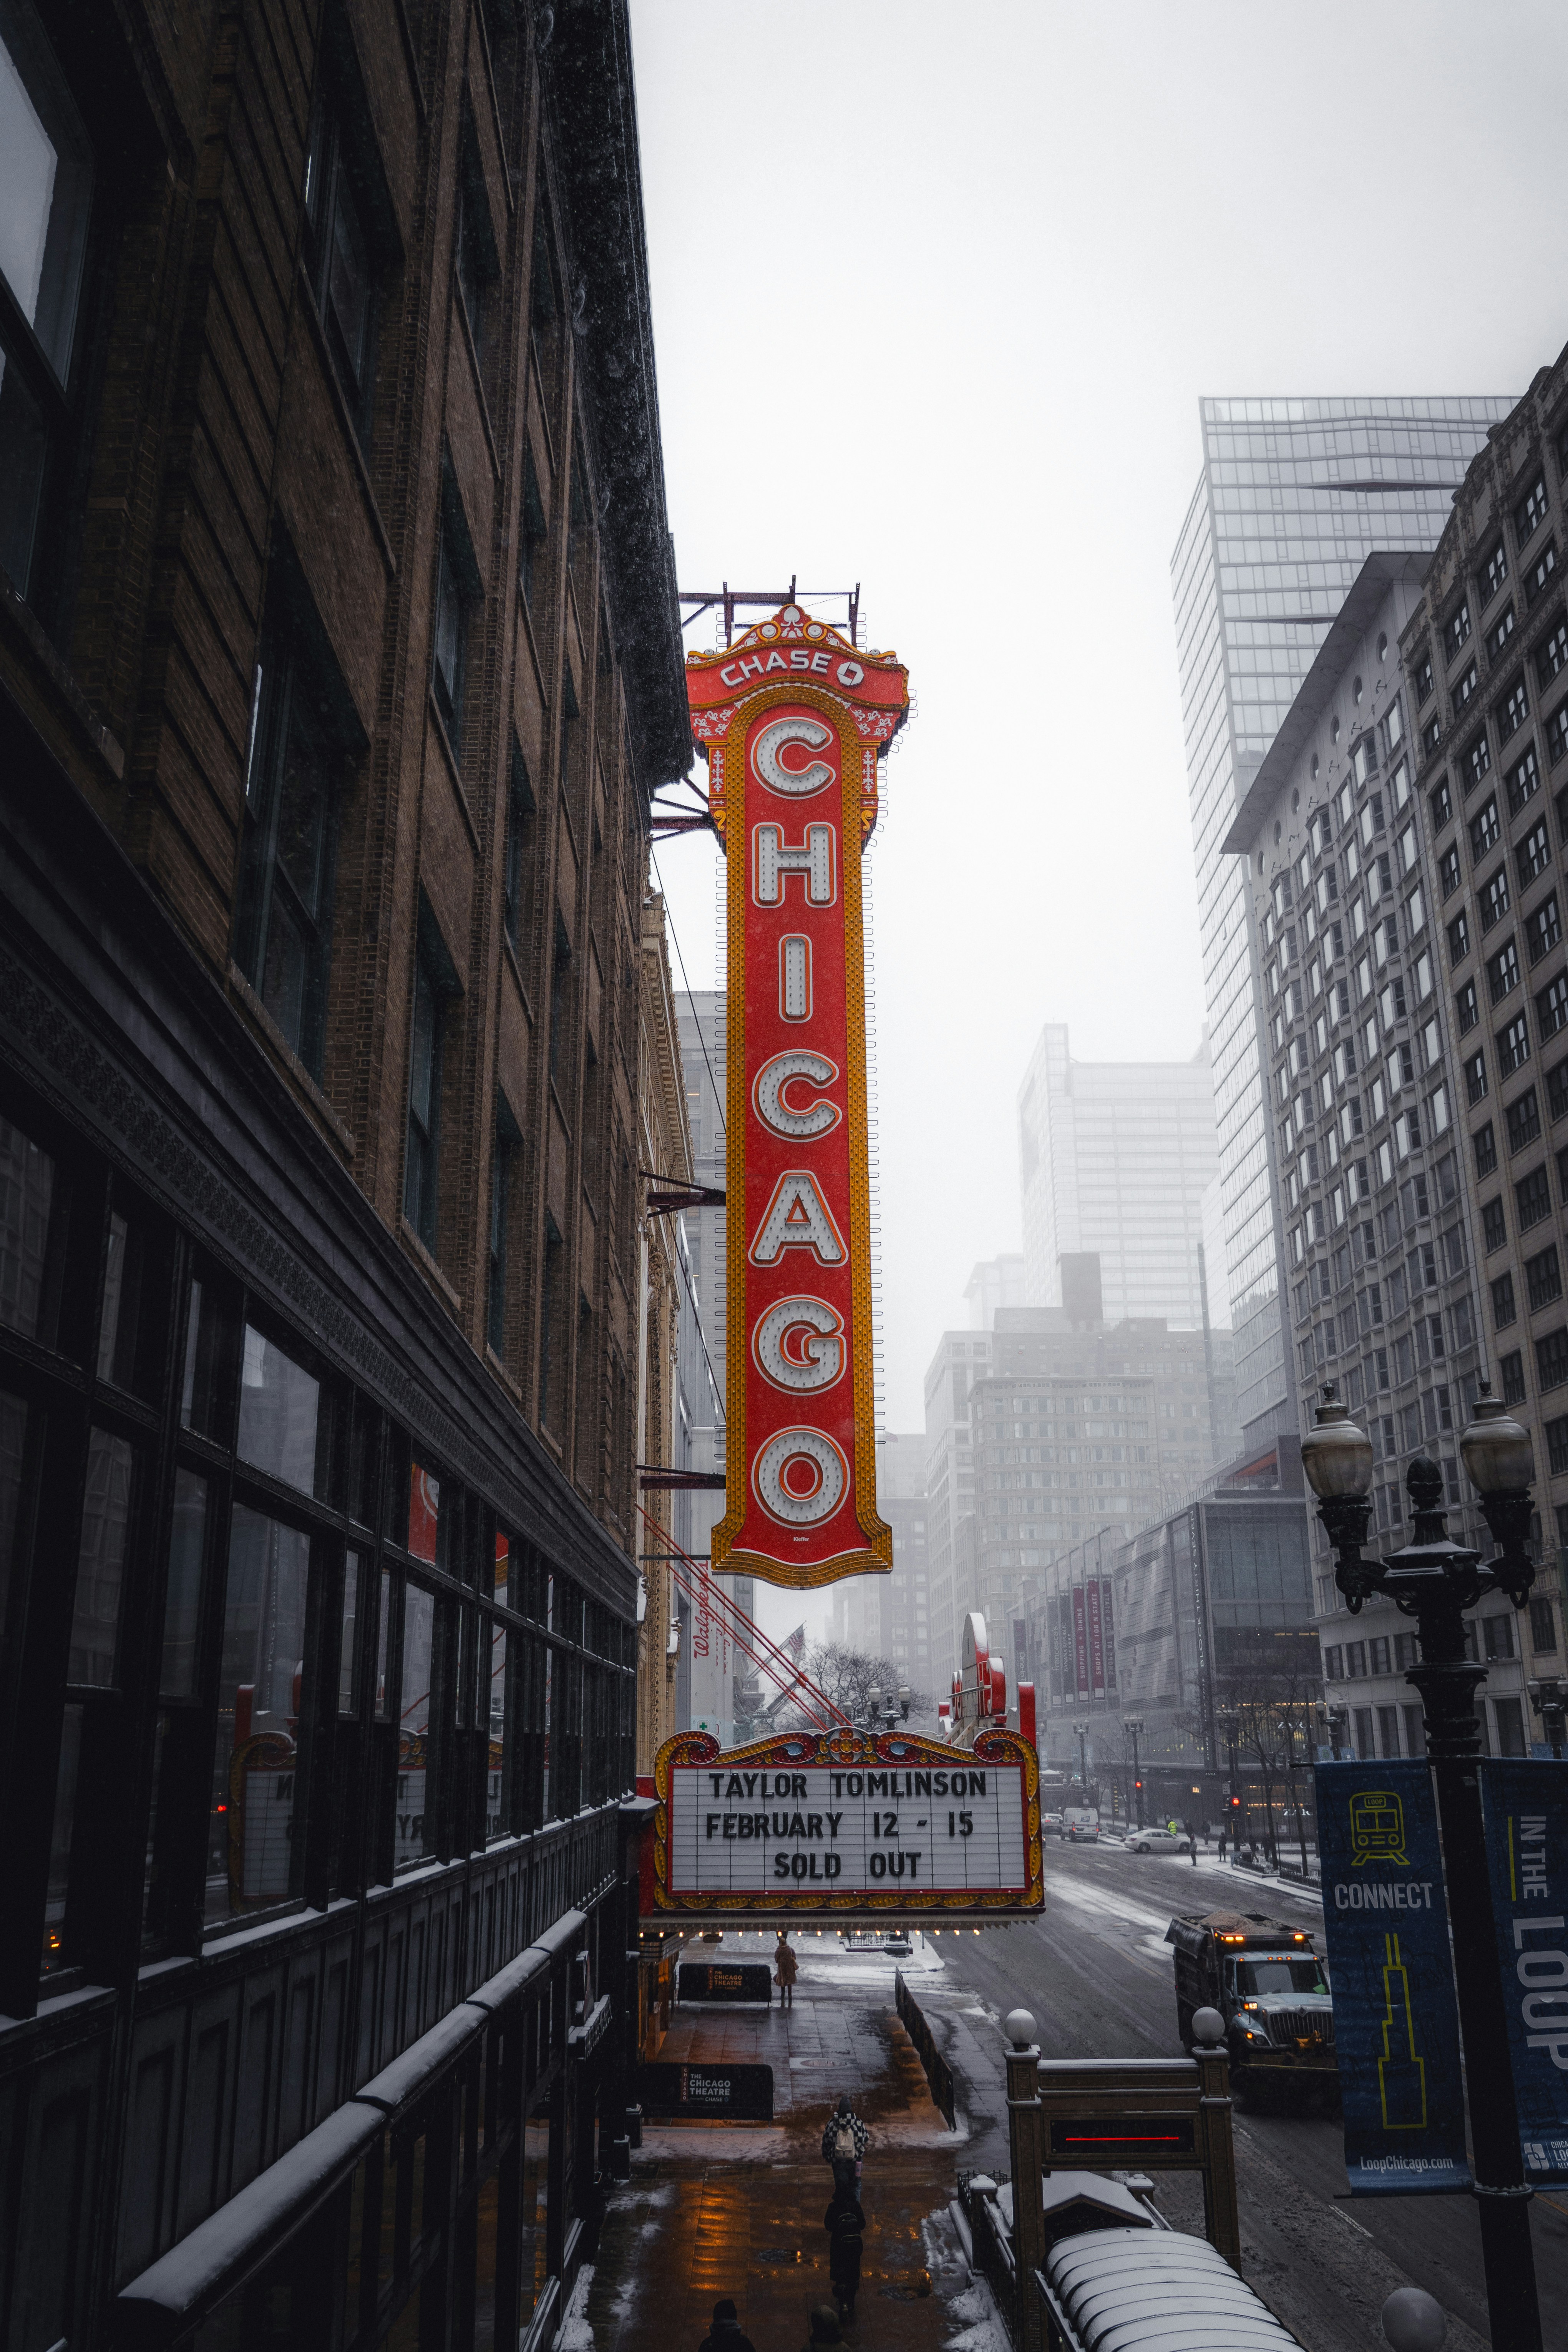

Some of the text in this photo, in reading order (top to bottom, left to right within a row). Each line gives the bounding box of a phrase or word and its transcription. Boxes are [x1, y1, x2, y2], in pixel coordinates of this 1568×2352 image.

[720, 650, 833, 687] CHASE
[747, 716, 850, 1530] CHICAGO
[1052, 1626, 1060, 1671] francesca's
[709, 1770, 987, 1798] TAYLOR TOMLINSON
[706, 1811, 843, 1838] FEBRUARY
[874, 1811, 899, 1837] 12
[949, 1810, 974, 1837] 15
[774, 1851, 922, 1879] SOLD OUT
[1520, 1815, 1548, 1899] IN THE
[1334, 1883, 1432, 1910] CONNECT
[1513, 1916, 1568, 2070] LOOP
[690, 2080, 731, 2088] CHICAGO
[690, 2088, 730, 2096] THEATRE
[1360, 2155, 1454, 2173] LoopChicago.com
